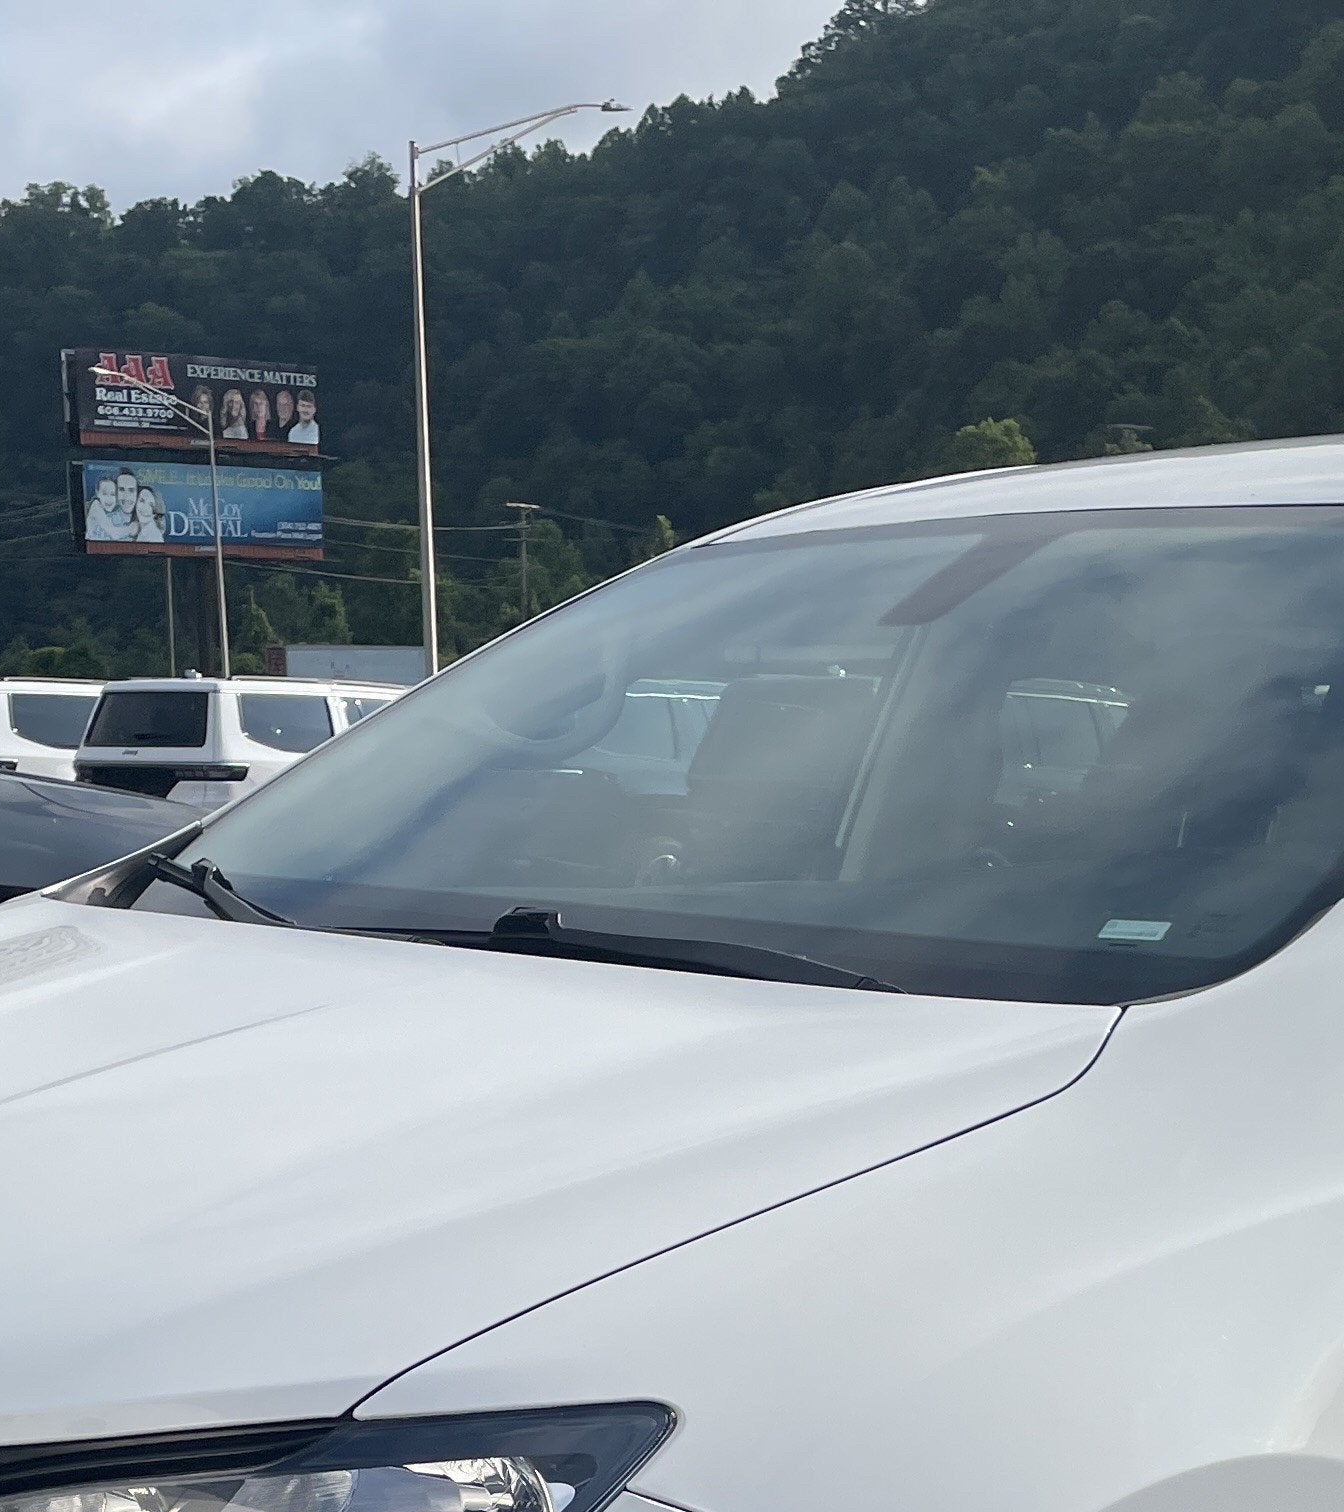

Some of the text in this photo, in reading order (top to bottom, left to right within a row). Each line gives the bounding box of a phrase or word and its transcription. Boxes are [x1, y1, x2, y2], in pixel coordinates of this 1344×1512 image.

[187, 364, 318, 388] EXPERIENCE MATTERS
[95, 387, 127, 403] Real
[168, 510, 249, 538] DENTAL
